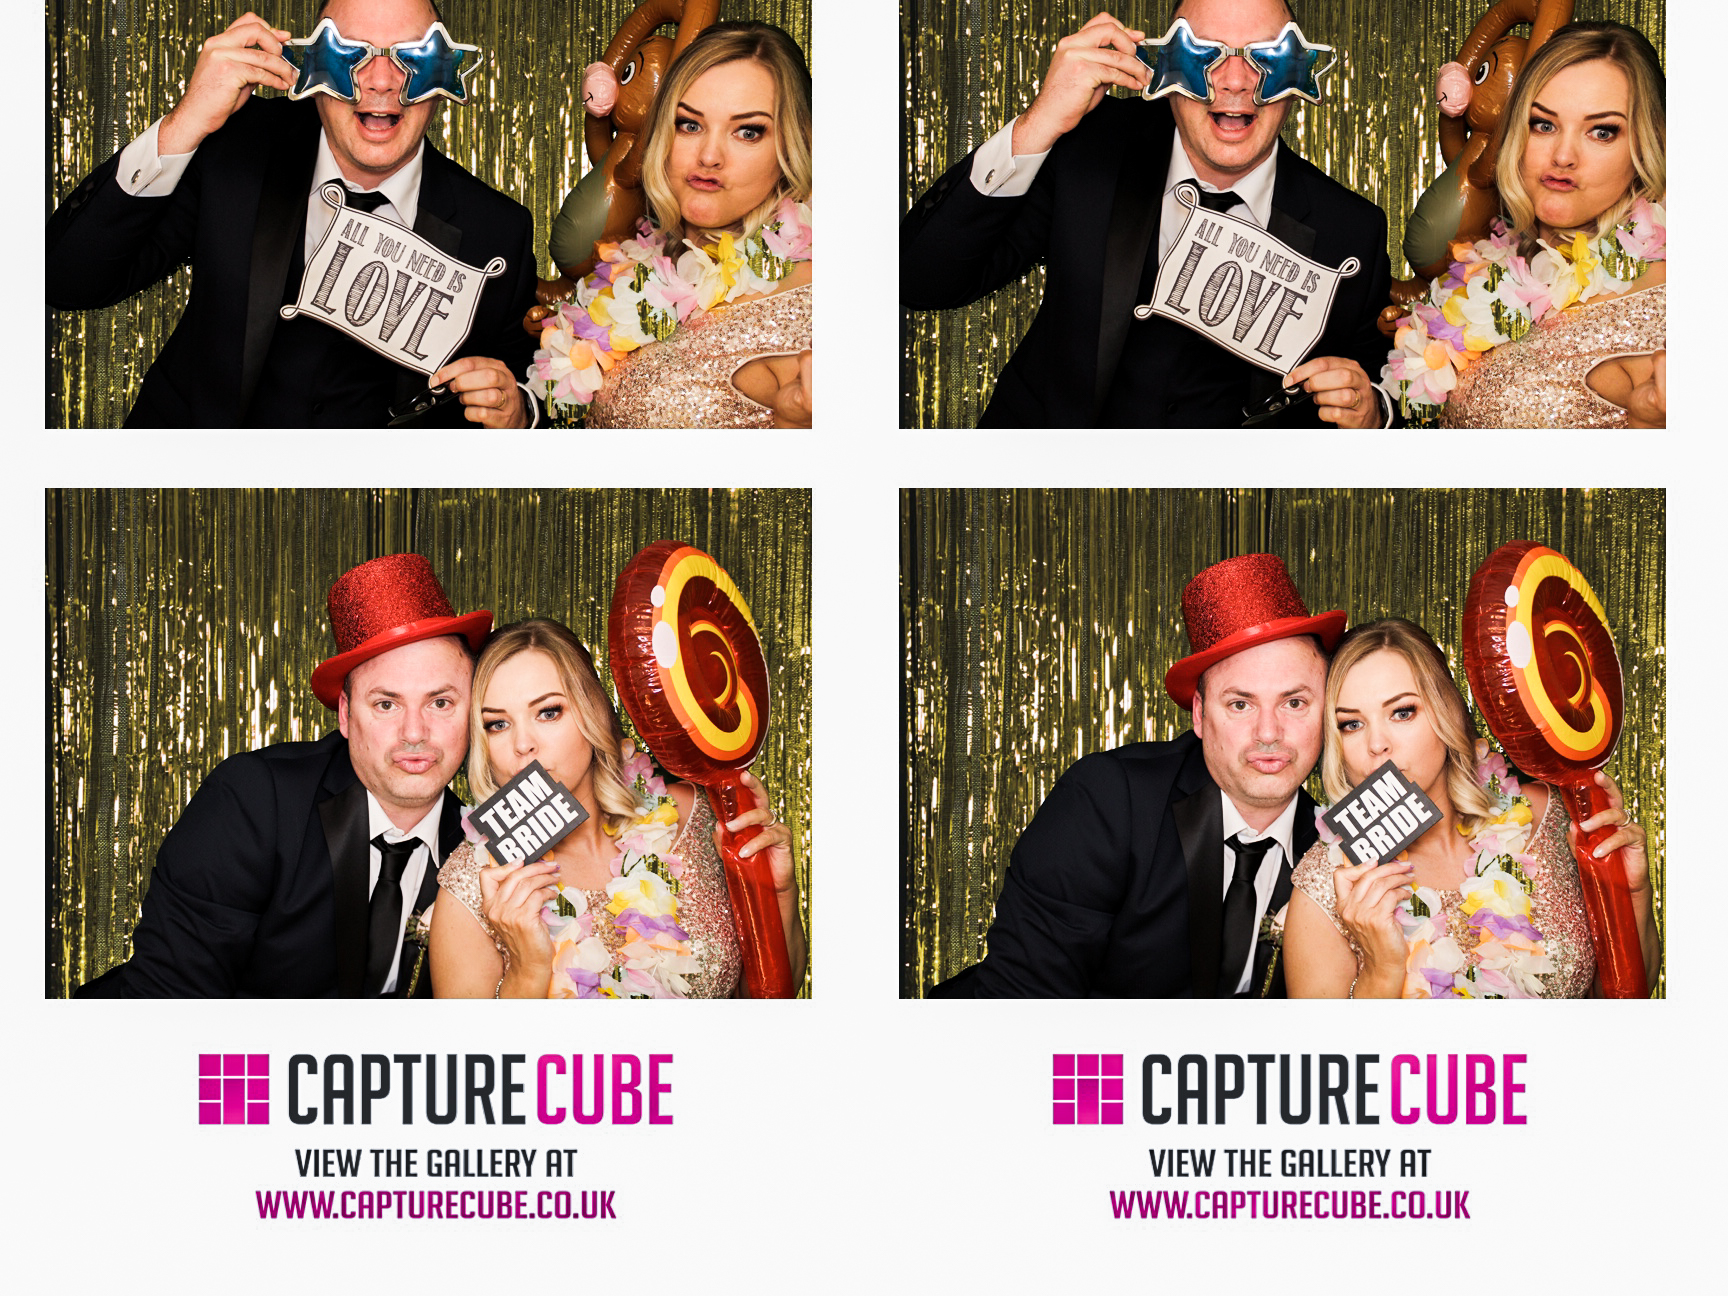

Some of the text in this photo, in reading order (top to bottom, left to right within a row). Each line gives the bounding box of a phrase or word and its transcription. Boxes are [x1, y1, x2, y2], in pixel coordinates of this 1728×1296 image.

[340, 218, 467, 294] ALL YOU NEED IS
[1194, 218, 1321, 294] ALL YOU NEED IS
[310, 240, 455, 362] LOVE
[1164, 240, 1309, 362] LOVE
[478, 769, 554, 839] TEAM
[495, 792, 580, 865] BRIDE
[1332, 769, 1408, 839] TEAM
[1349, 792, 1434, 865] BRIDE
